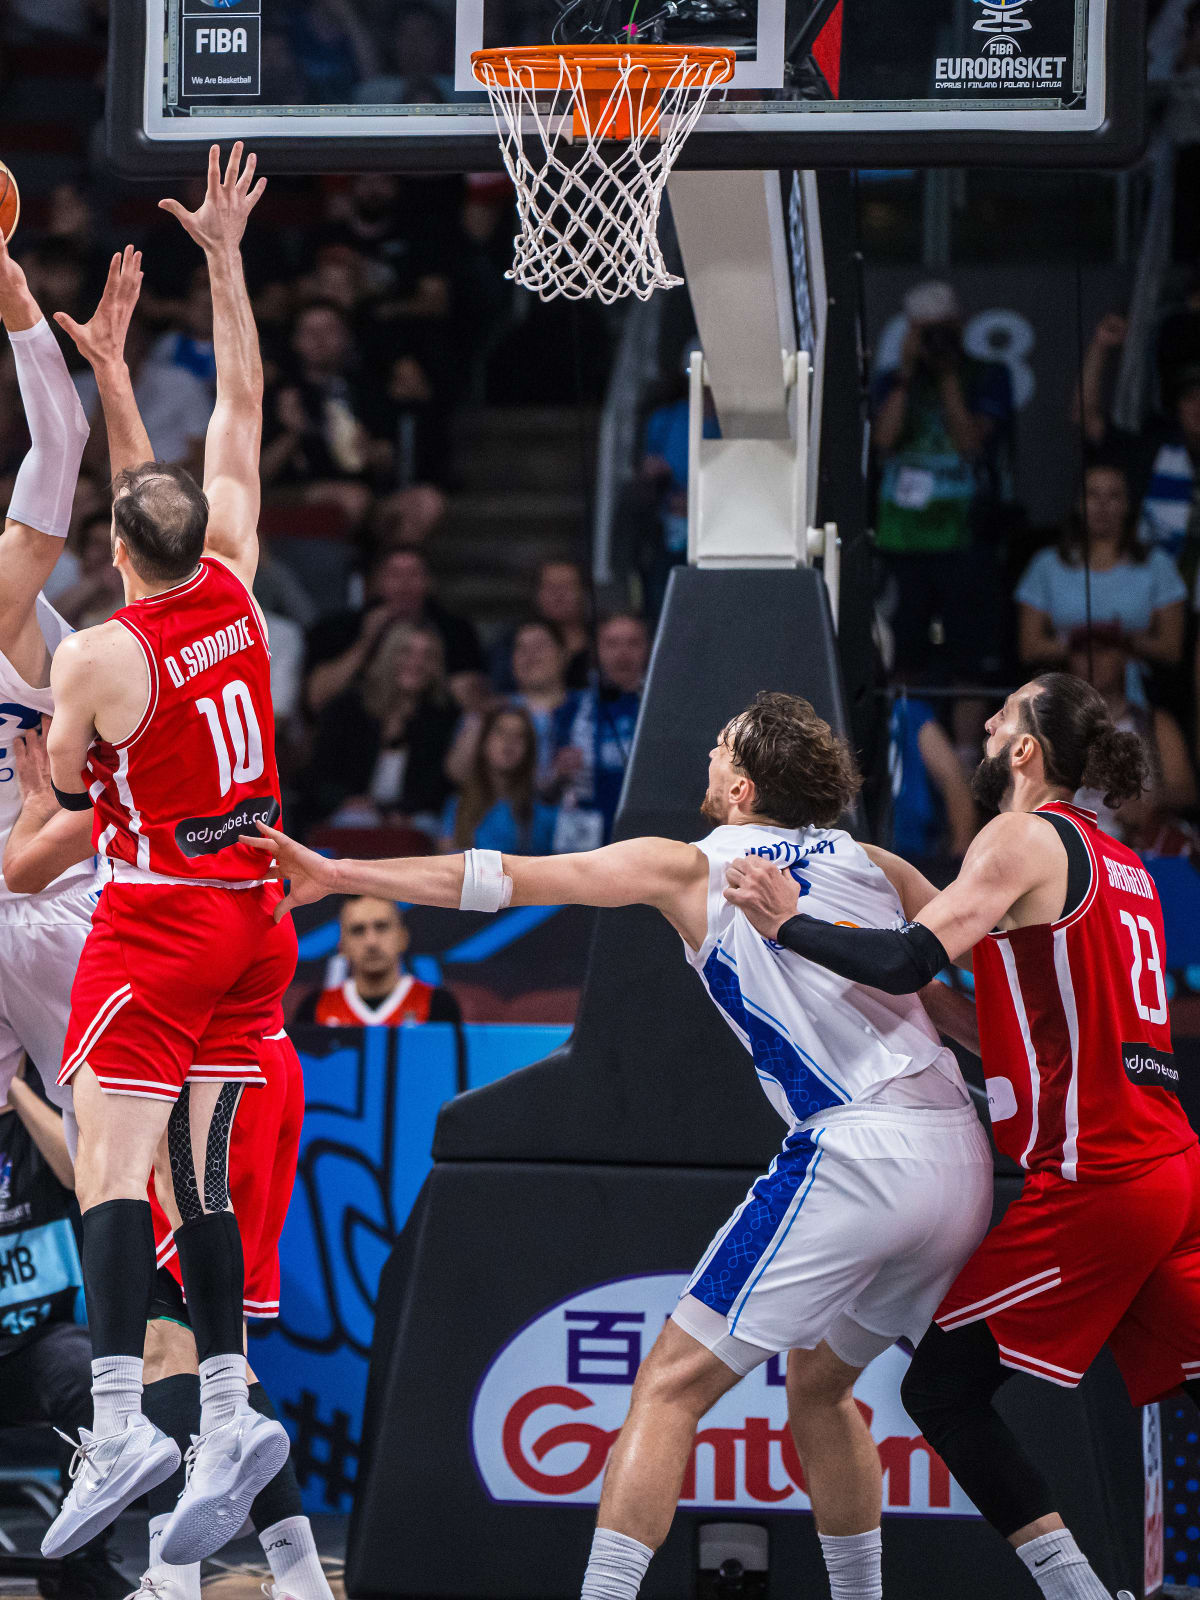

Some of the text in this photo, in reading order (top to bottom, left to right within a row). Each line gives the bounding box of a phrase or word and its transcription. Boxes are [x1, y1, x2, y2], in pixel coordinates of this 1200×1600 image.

[195, 27, 248, 54] FIBA
[990, 43, 1013, 55] FIBA
[191, 75, 252, 85] We Are Basketball
[935, 57, 1067, 80] EUROBASKET
[968, 81, 998, 89] FINLAND
[1003, 81, 1031, 89] POLAND
[164, 615, 255, 689] D.SANADZE
[195, 679, 264, 798] 10
[1102, 855, 1154, 900] SHENGELIA
[502, 1385, 951, 1508] Gntn
